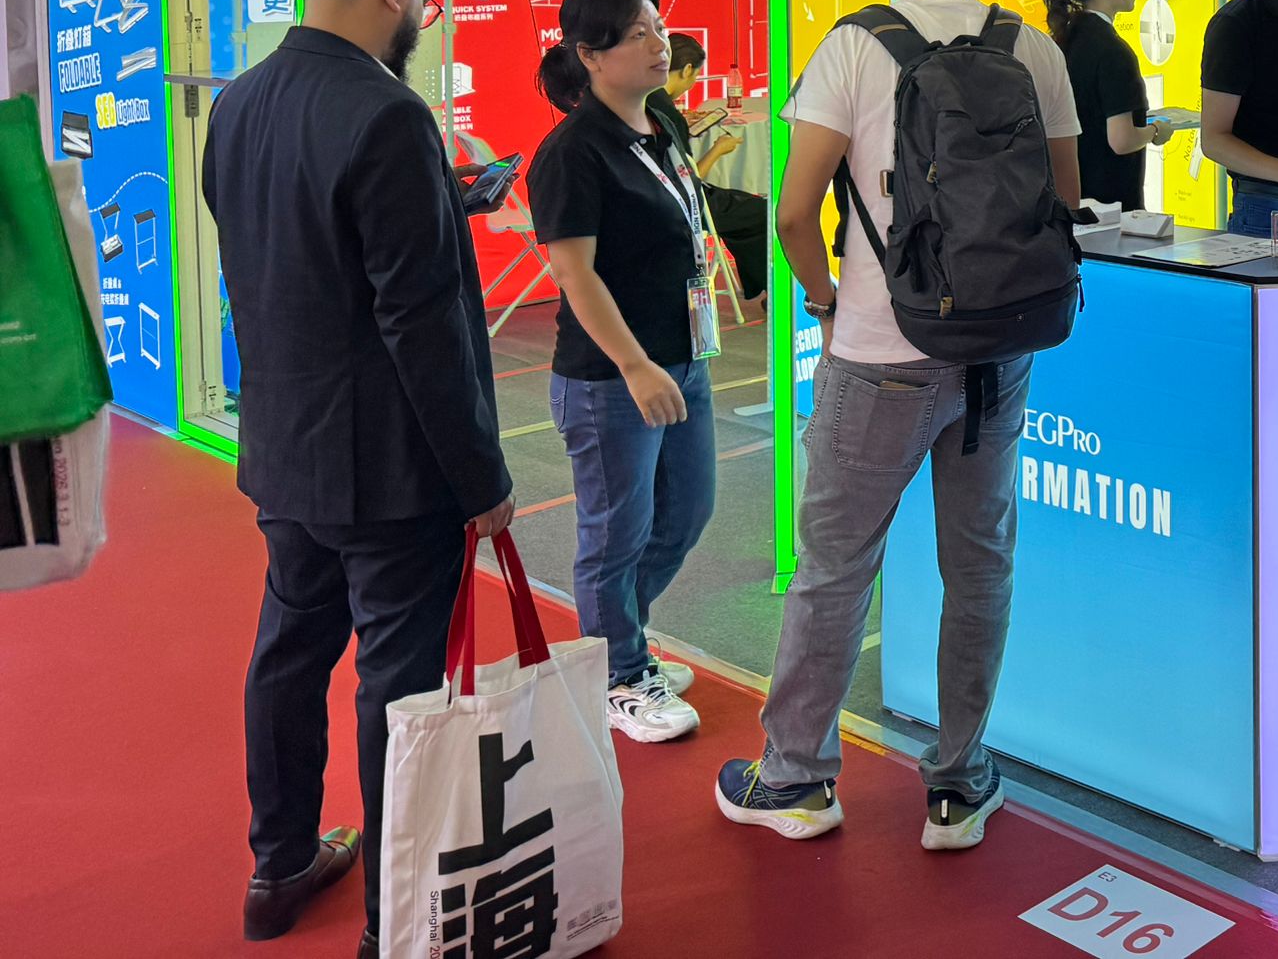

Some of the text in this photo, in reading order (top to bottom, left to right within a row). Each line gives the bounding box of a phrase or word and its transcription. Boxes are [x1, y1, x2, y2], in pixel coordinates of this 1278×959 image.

[476, 4, 507, 13] SYSTEM
[58, 52, 102, 93] FOLDABLE
[95, 92, 150, 129] SEG Light Box
[691, 193, 700, 218] CHINA
[1022, 455, 1171, 538] RMATION
[1097, 871, 1118, 883] E3
[429, 890, 439, 942] Shanghai
[1047, 887, 1175, 954] D16
